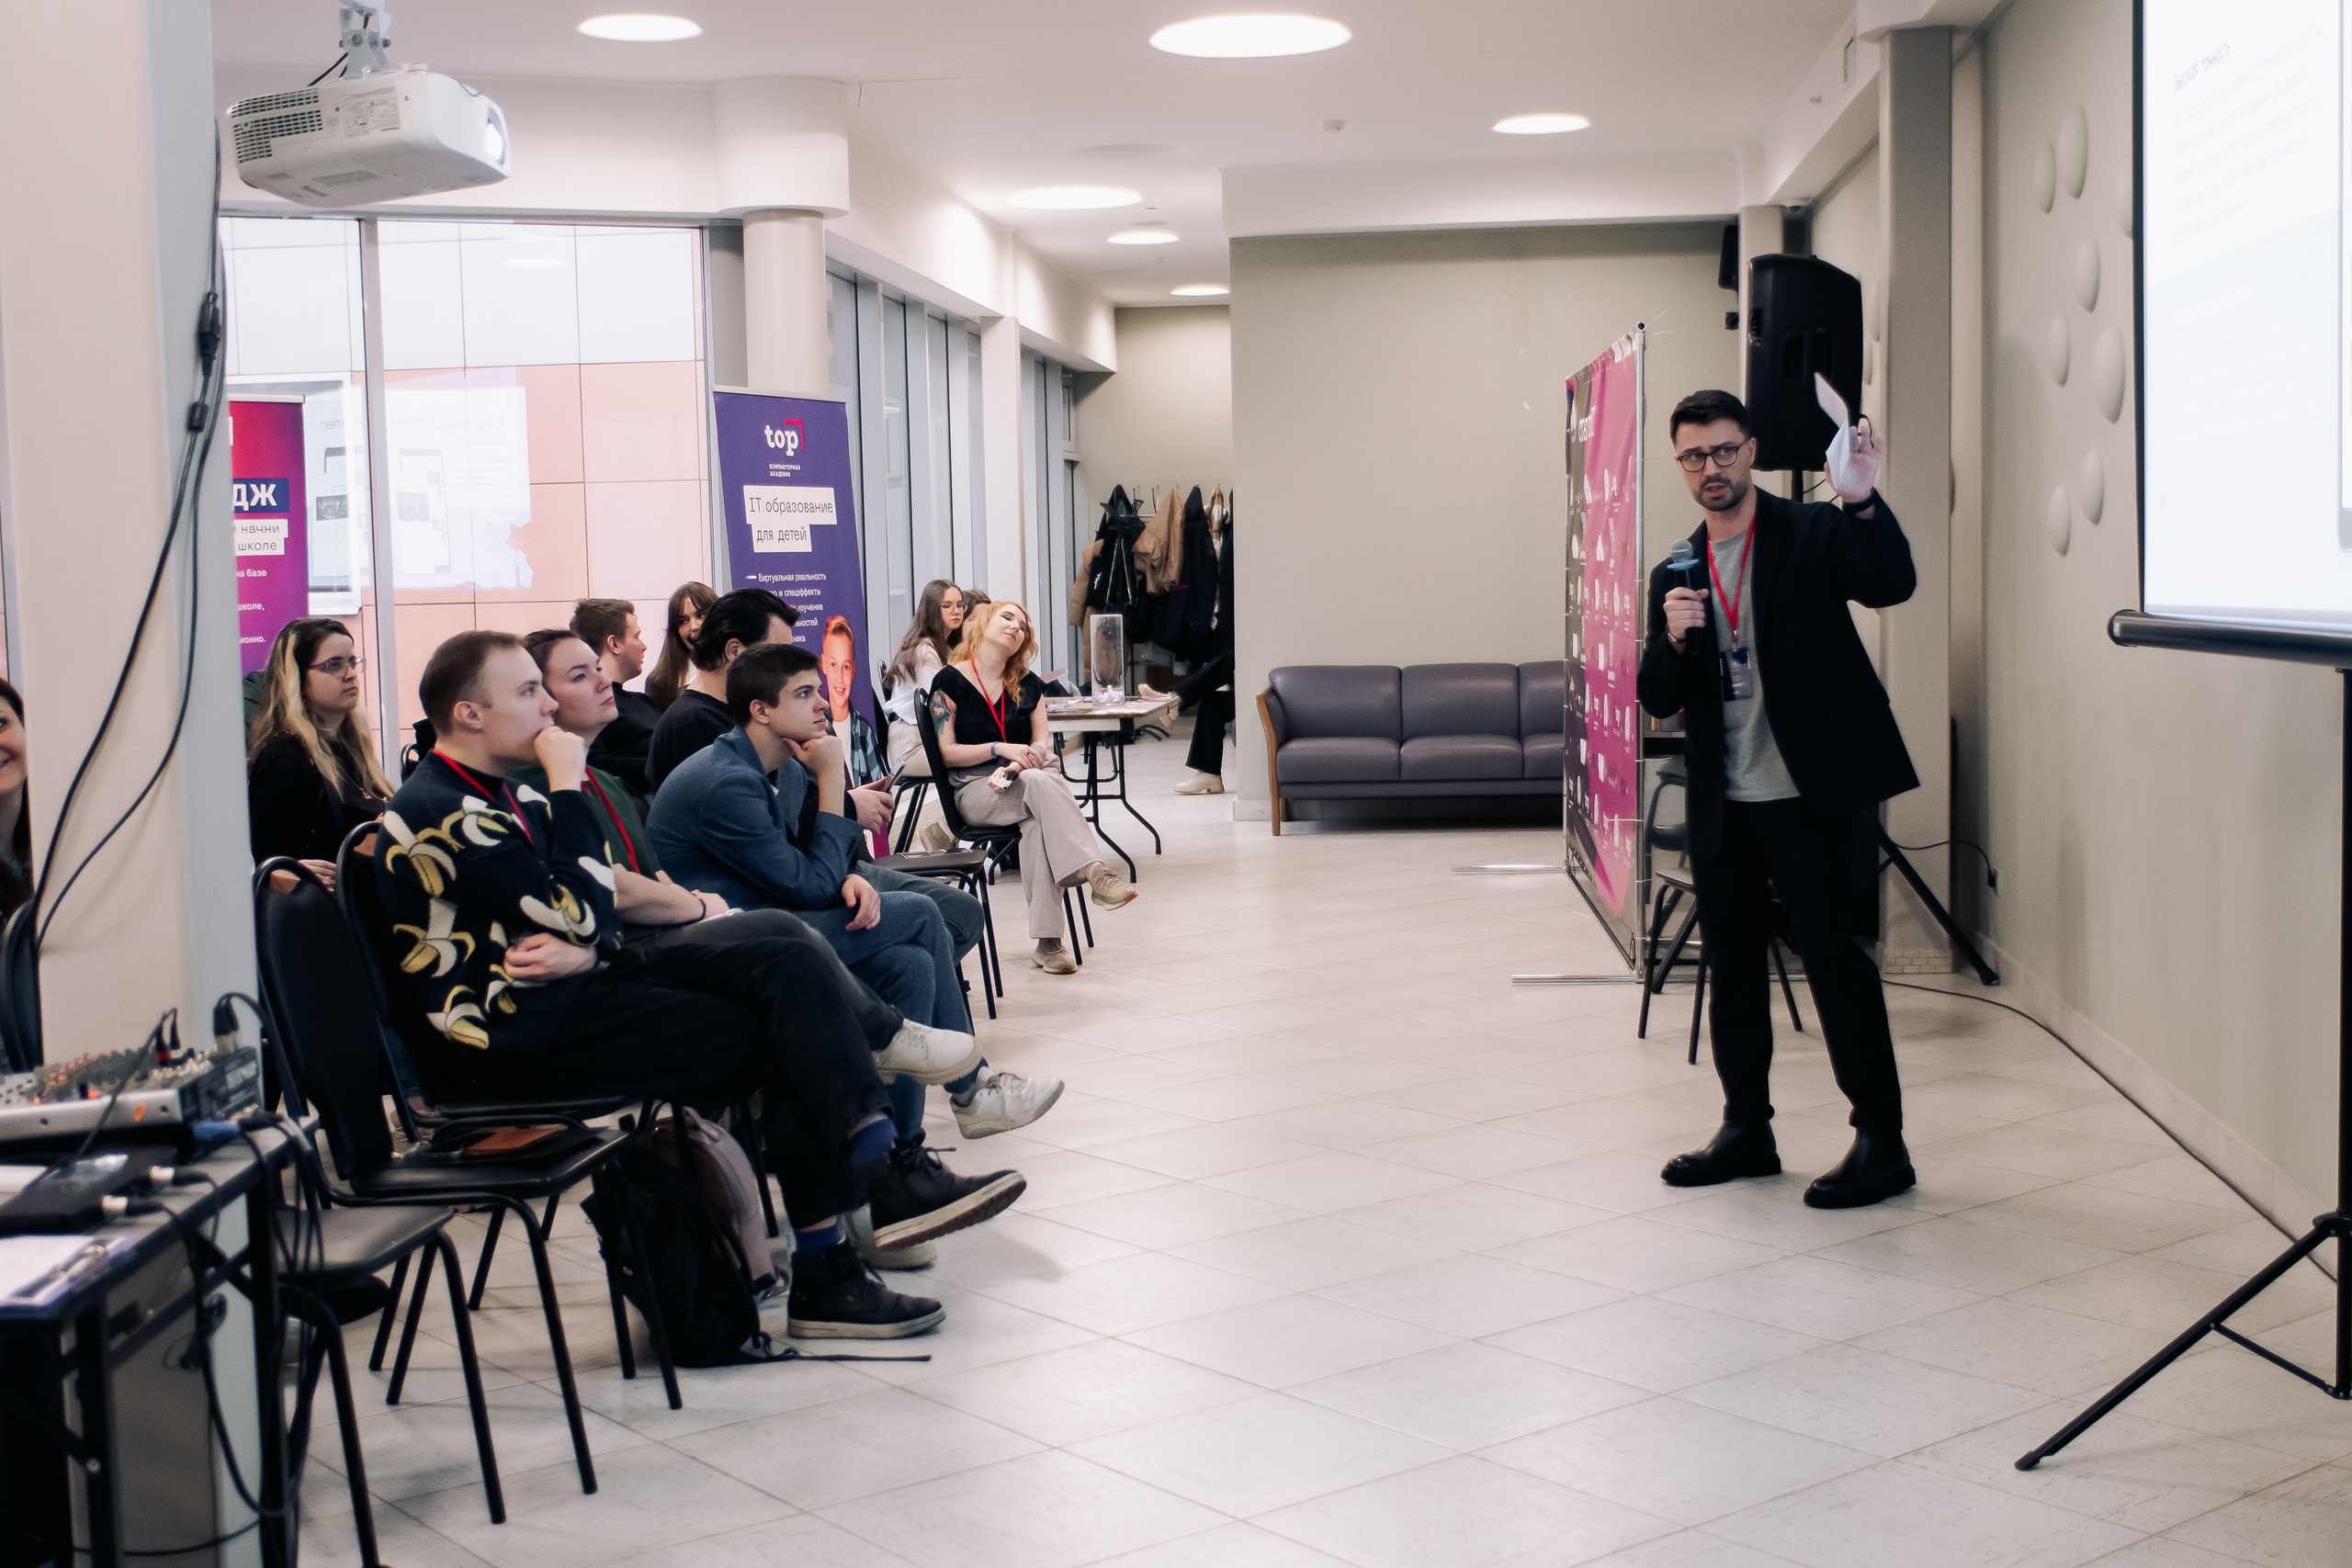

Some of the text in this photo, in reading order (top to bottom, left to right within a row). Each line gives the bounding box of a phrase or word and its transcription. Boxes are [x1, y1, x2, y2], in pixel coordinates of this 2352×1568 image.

[764, 425, 799, 457] top
[765, 497, 833, 515] образование
[241, 525, 280, 534] начни
[756, 525, 808, 543] для детей
[238, 542, 277, 550] школе
[246, 568, 267, 578] базе
[758, 573, 827, 584] Виртуальная реальность
[784, 588, 821, 598] спецэффекты
